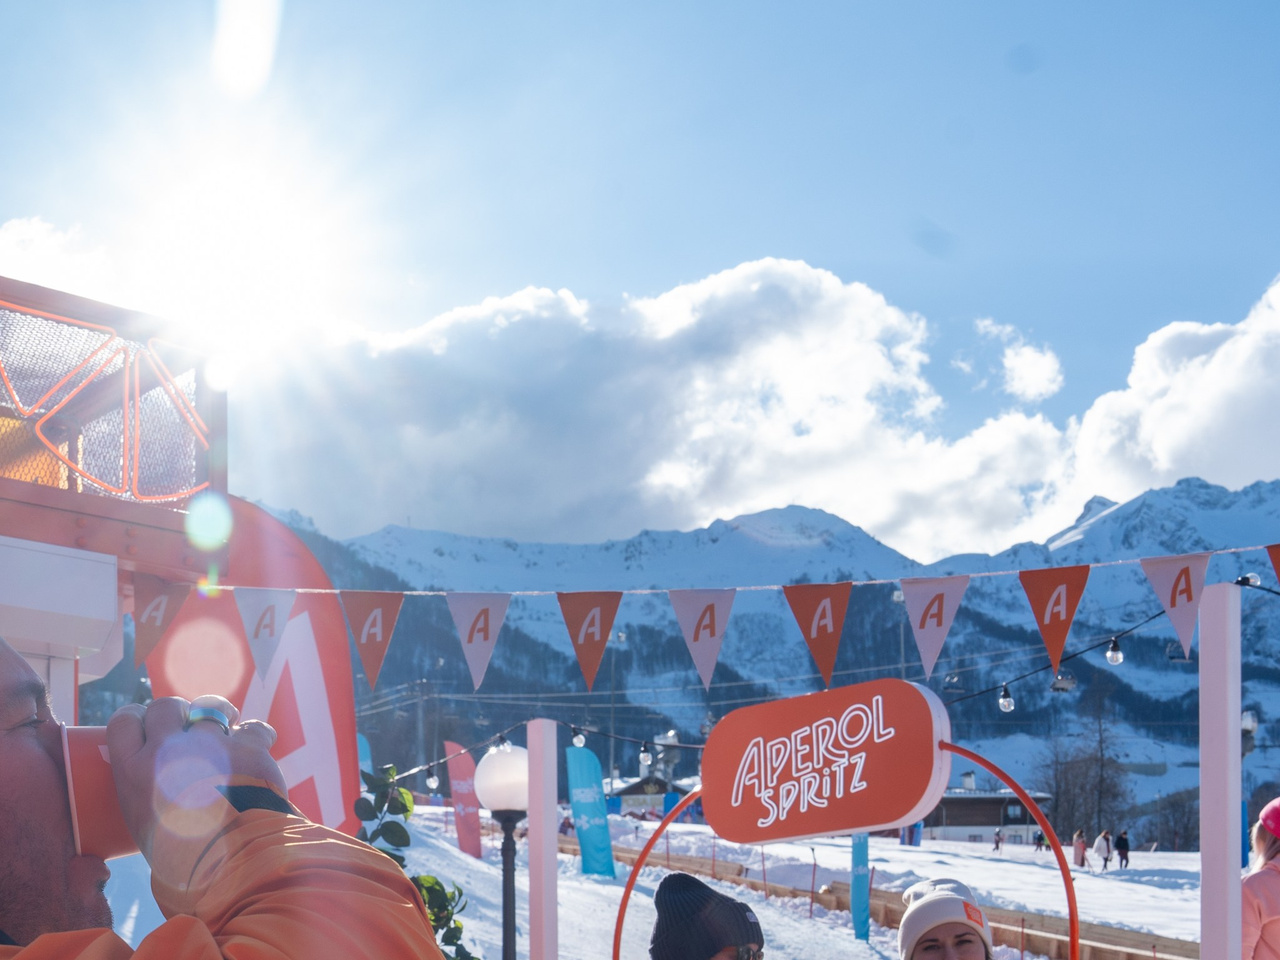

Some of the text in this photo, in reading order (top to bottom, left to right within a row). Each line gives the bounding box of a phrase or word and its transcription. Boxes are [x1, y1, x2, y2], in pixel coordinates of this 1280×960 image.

[1043, 584, 1068, 625] A
[1169, 567, 1194, 609] A
[139, 595, 169, 626] A
[253, 604, 276, 639] A
[360, 607, 383, 644] A
[466, 607, 490, 645] A
[577, 606, 602, 645] A
[692, 602, 717, 643] A
[810, 597, 834, 639] A
[918, 592, 945, 630] A
[731, 695, 895, 807] APEROL
